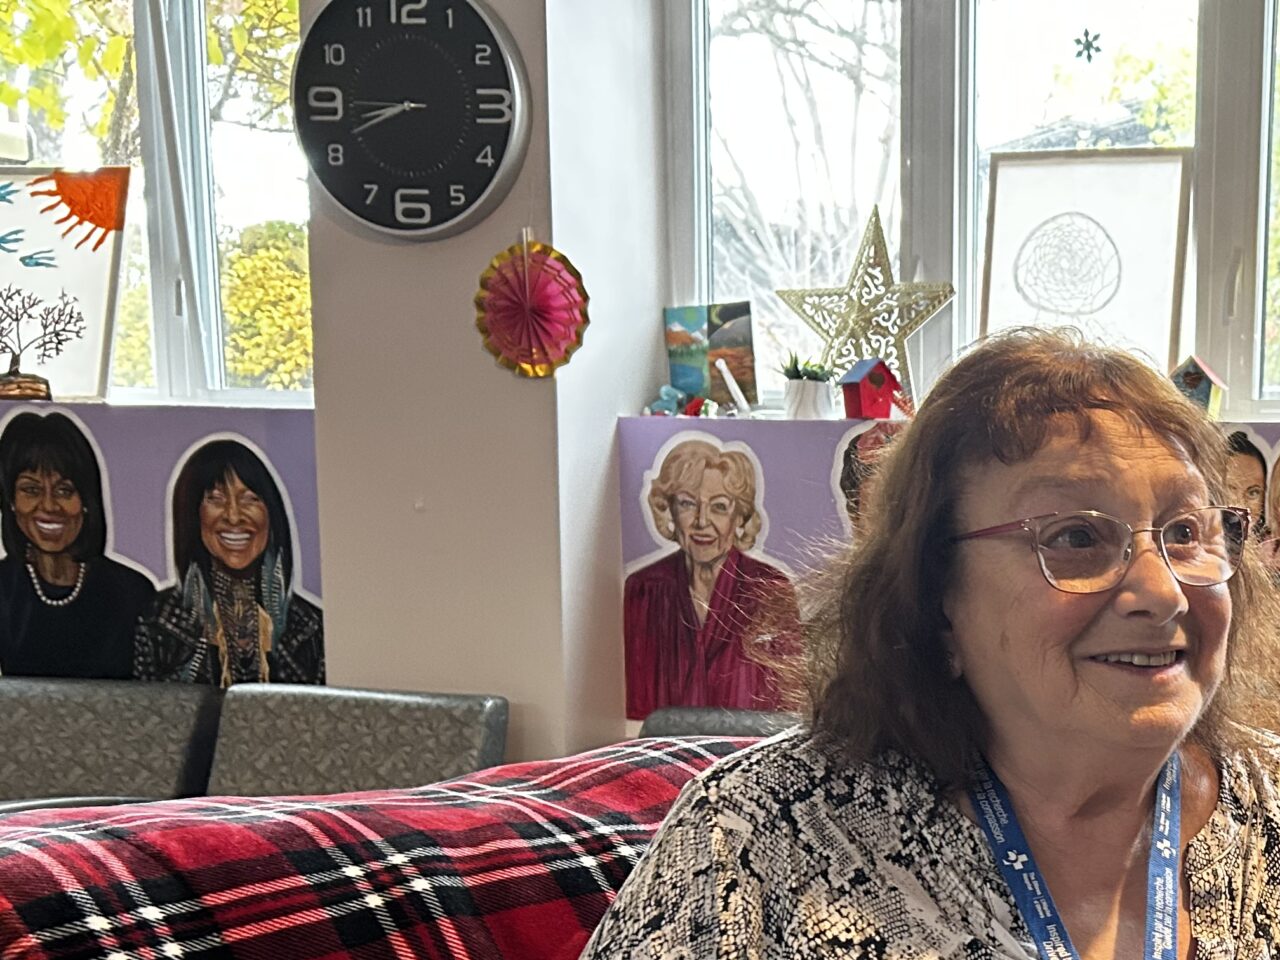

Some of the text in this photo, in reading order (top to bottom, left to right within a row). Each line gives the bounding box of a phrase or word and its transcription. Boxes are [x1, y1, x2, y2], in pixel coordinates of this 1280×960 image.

[356, 7, 372, 27] 11
[389, 0, 427, 24] 12
[446, 8, 453, 28] 1
[323, 43, 345, 66] 10
[475, 44, 491, 65] 2
[308, 86, 343, 121] 9
[475, 88, 512, 124] 3
[327, 143, 344, 166] 8
[475, 145, 495, 167] 4
[363, 184, 378, 205] 7
[450, 185, 466, 205] 5
[394, 189, 431, 224] 6
[1046, 924, 1072, 957] Inspired
